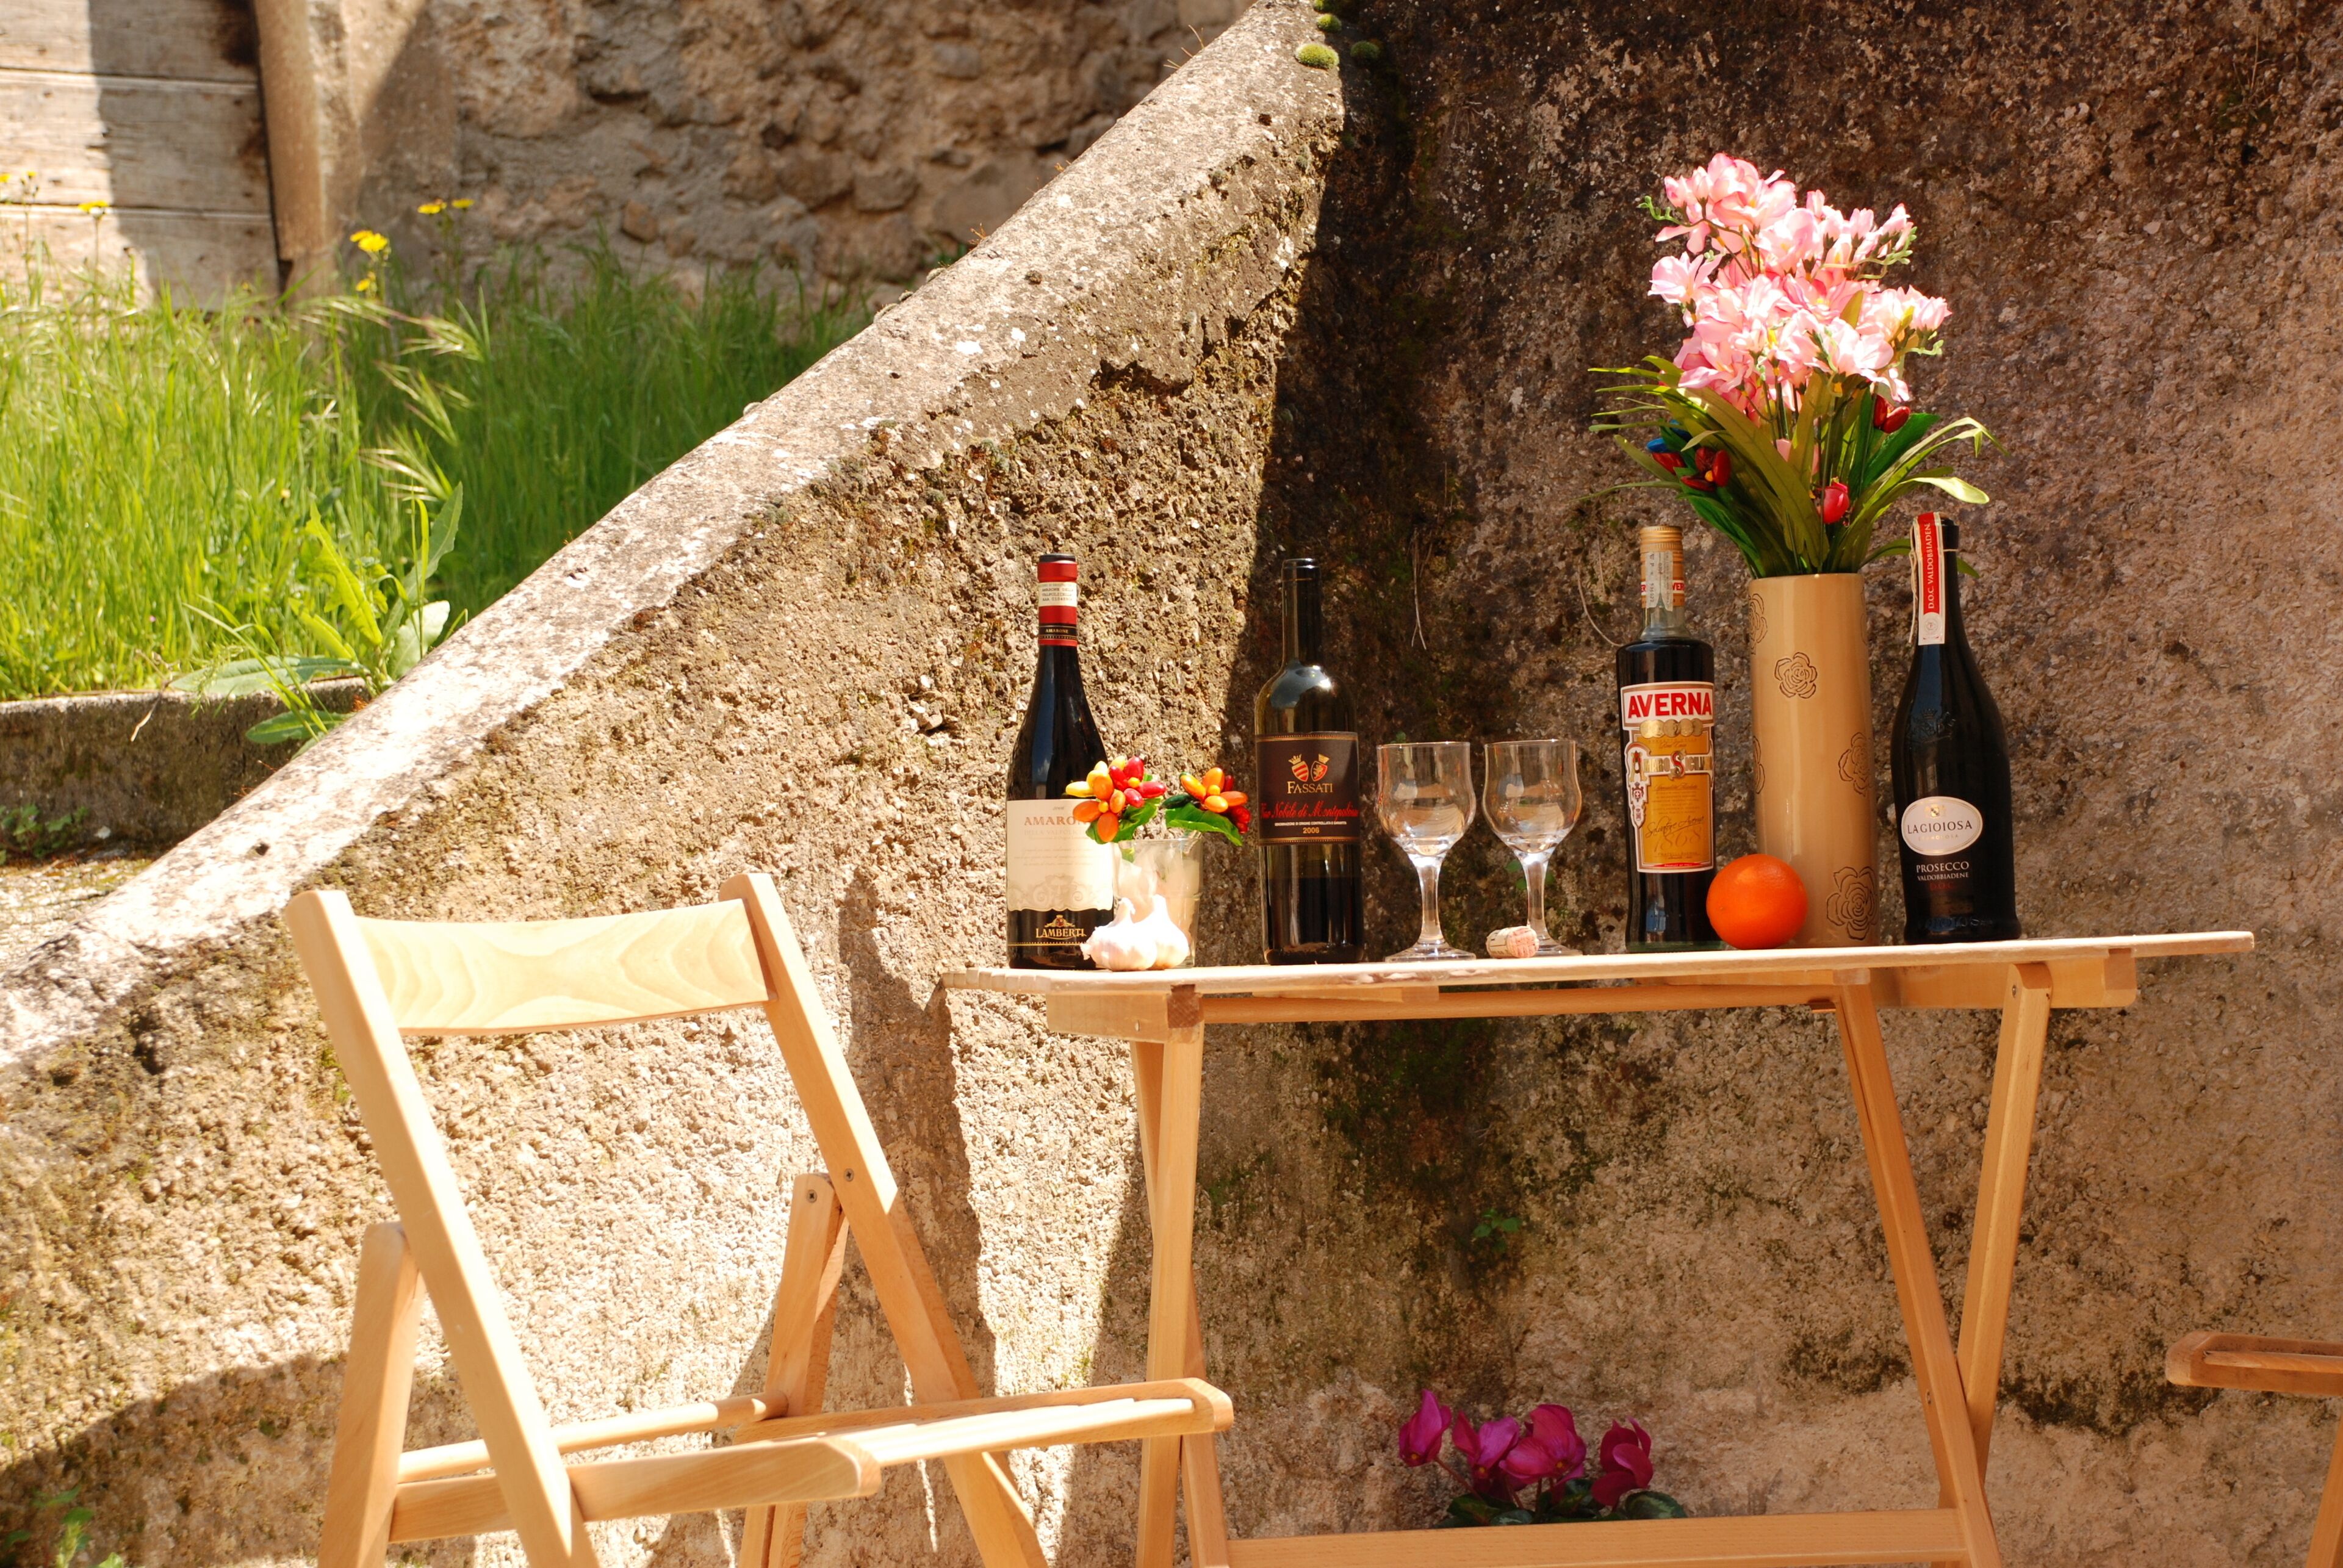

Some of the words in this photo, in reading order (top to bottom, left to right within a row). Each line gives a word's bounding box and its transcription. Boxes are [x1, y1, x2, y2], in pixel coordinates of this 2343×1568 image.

[1924, 523, 1934, 584] VALDOBBIADEN
[1628, 692, 1712, 718] AVERNA
[1287, 781, 1333, 794] FASSATI
[1024, 816, 1087, 825] AMARO
[1916, 861, 1970, 873] PROSECCO
[1917, 872, 1970, 882] VALDOBBIADENE
[1035, 928, 1087, 938] LAMBERTI
